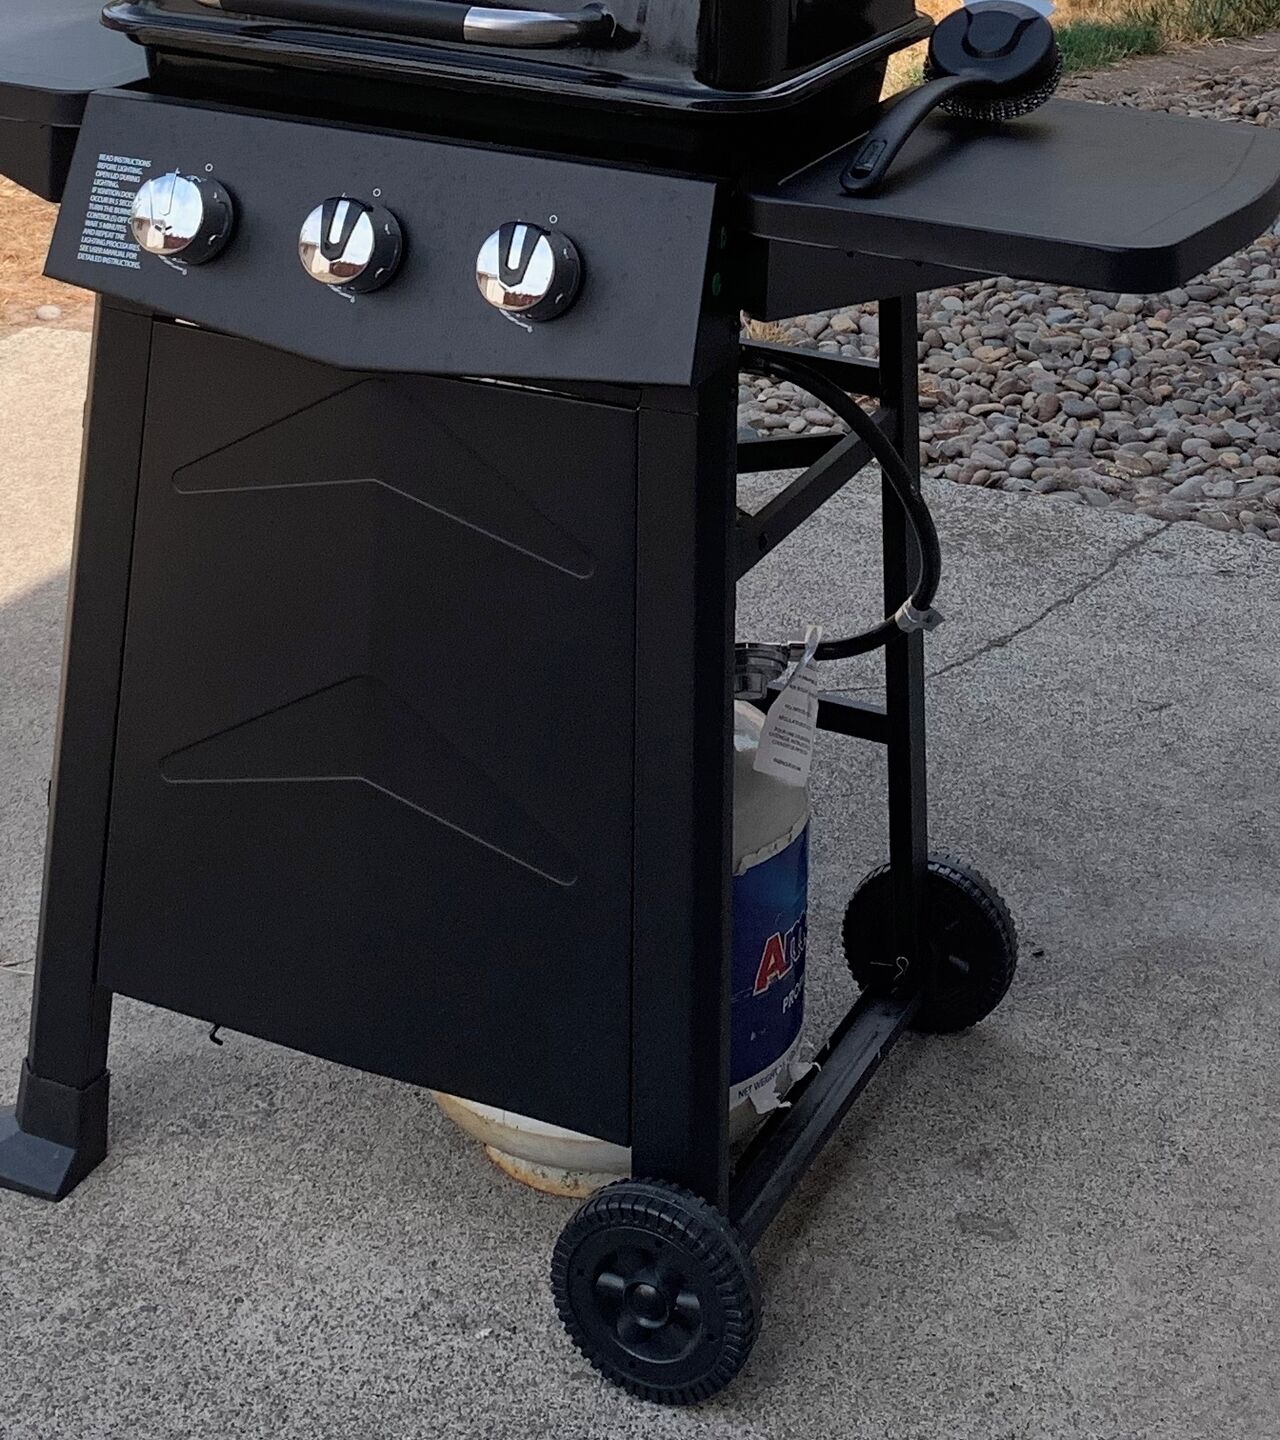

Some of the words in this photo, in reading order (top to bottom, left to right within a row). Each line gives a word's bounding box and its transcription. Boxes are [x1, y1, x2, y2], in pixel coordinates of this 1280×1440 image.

[97, 161, 117, 171] BEFORE
[99, 153, 114, 162] READ
[114, 156, 152, 168] INSTRUCTIONS
[95, 170, 111, 178] OPEN
[119, 174, 141, 183] DURING
[738, 1084, 753, 1099] NET
